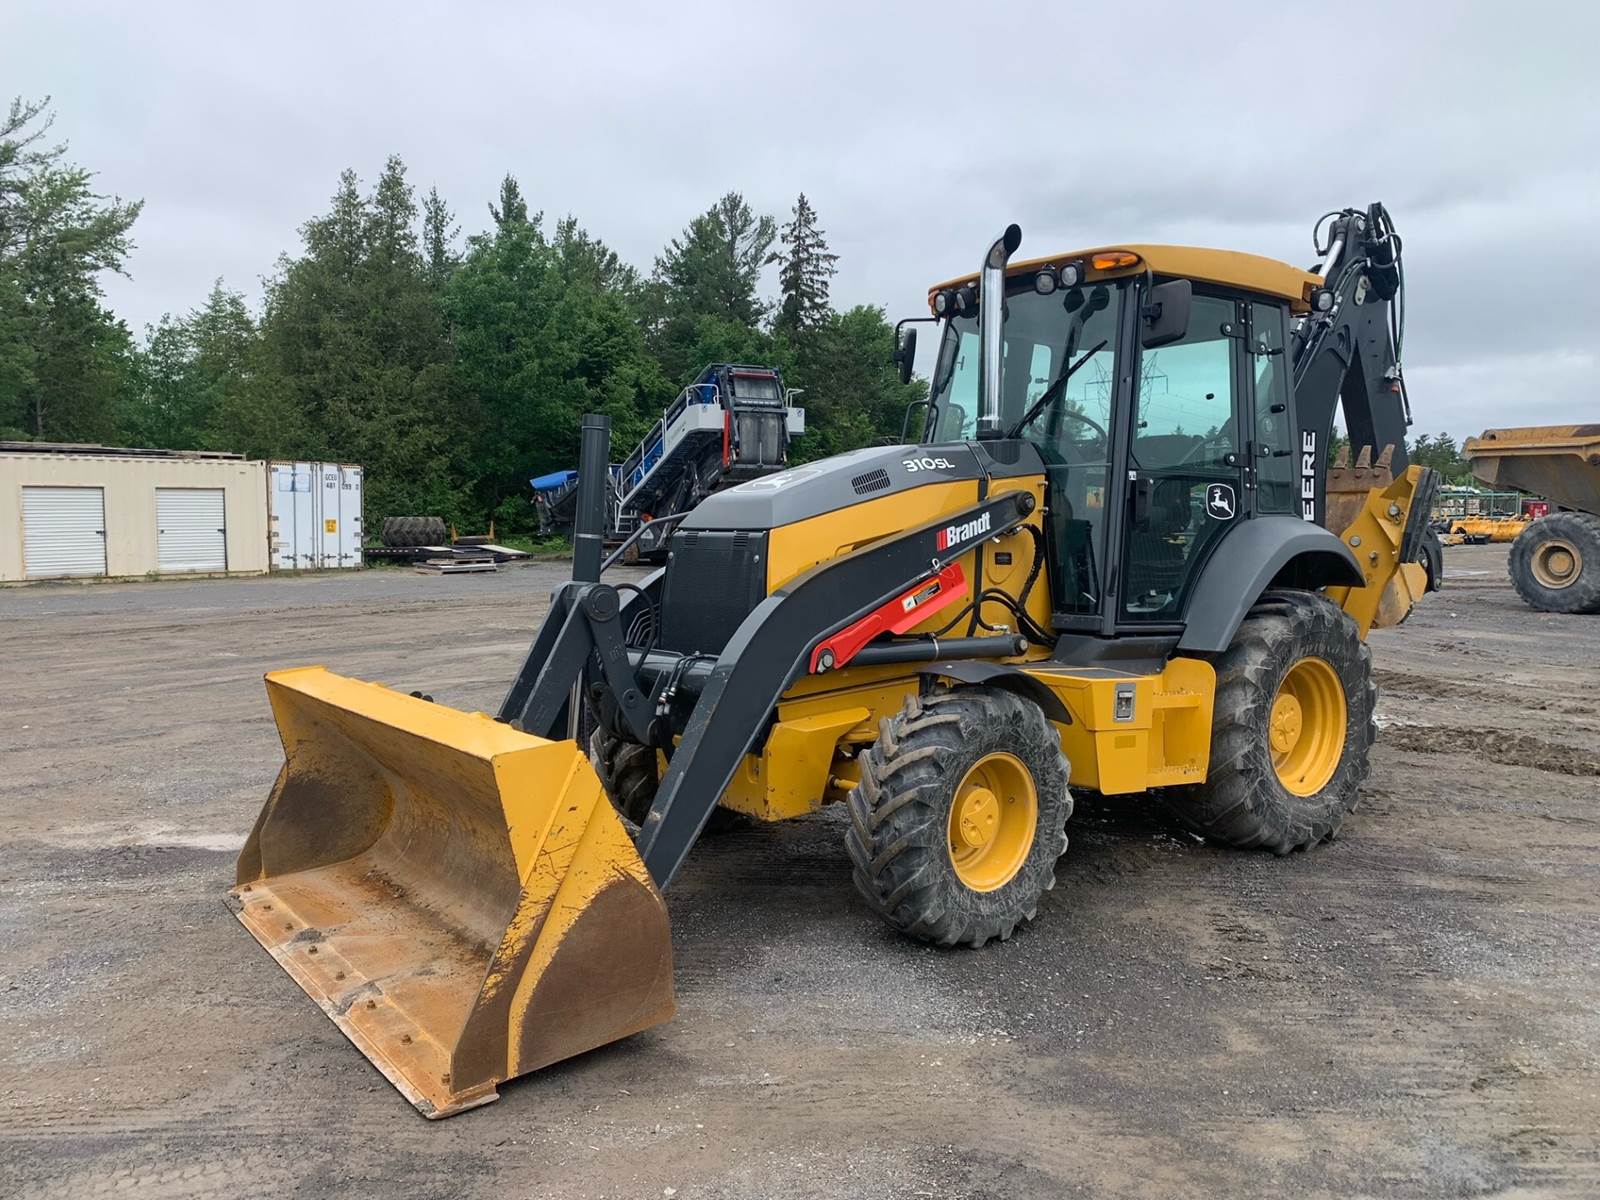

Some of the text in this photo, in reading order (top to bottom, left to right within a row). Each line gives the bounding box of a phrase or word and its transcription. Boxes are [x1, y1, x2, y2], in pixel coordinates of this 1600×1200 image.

[902, 457, 956, 473] 310SL
[1301, 431, 1316, 521] EERE
[946, 511, 991, 548] Brandt
